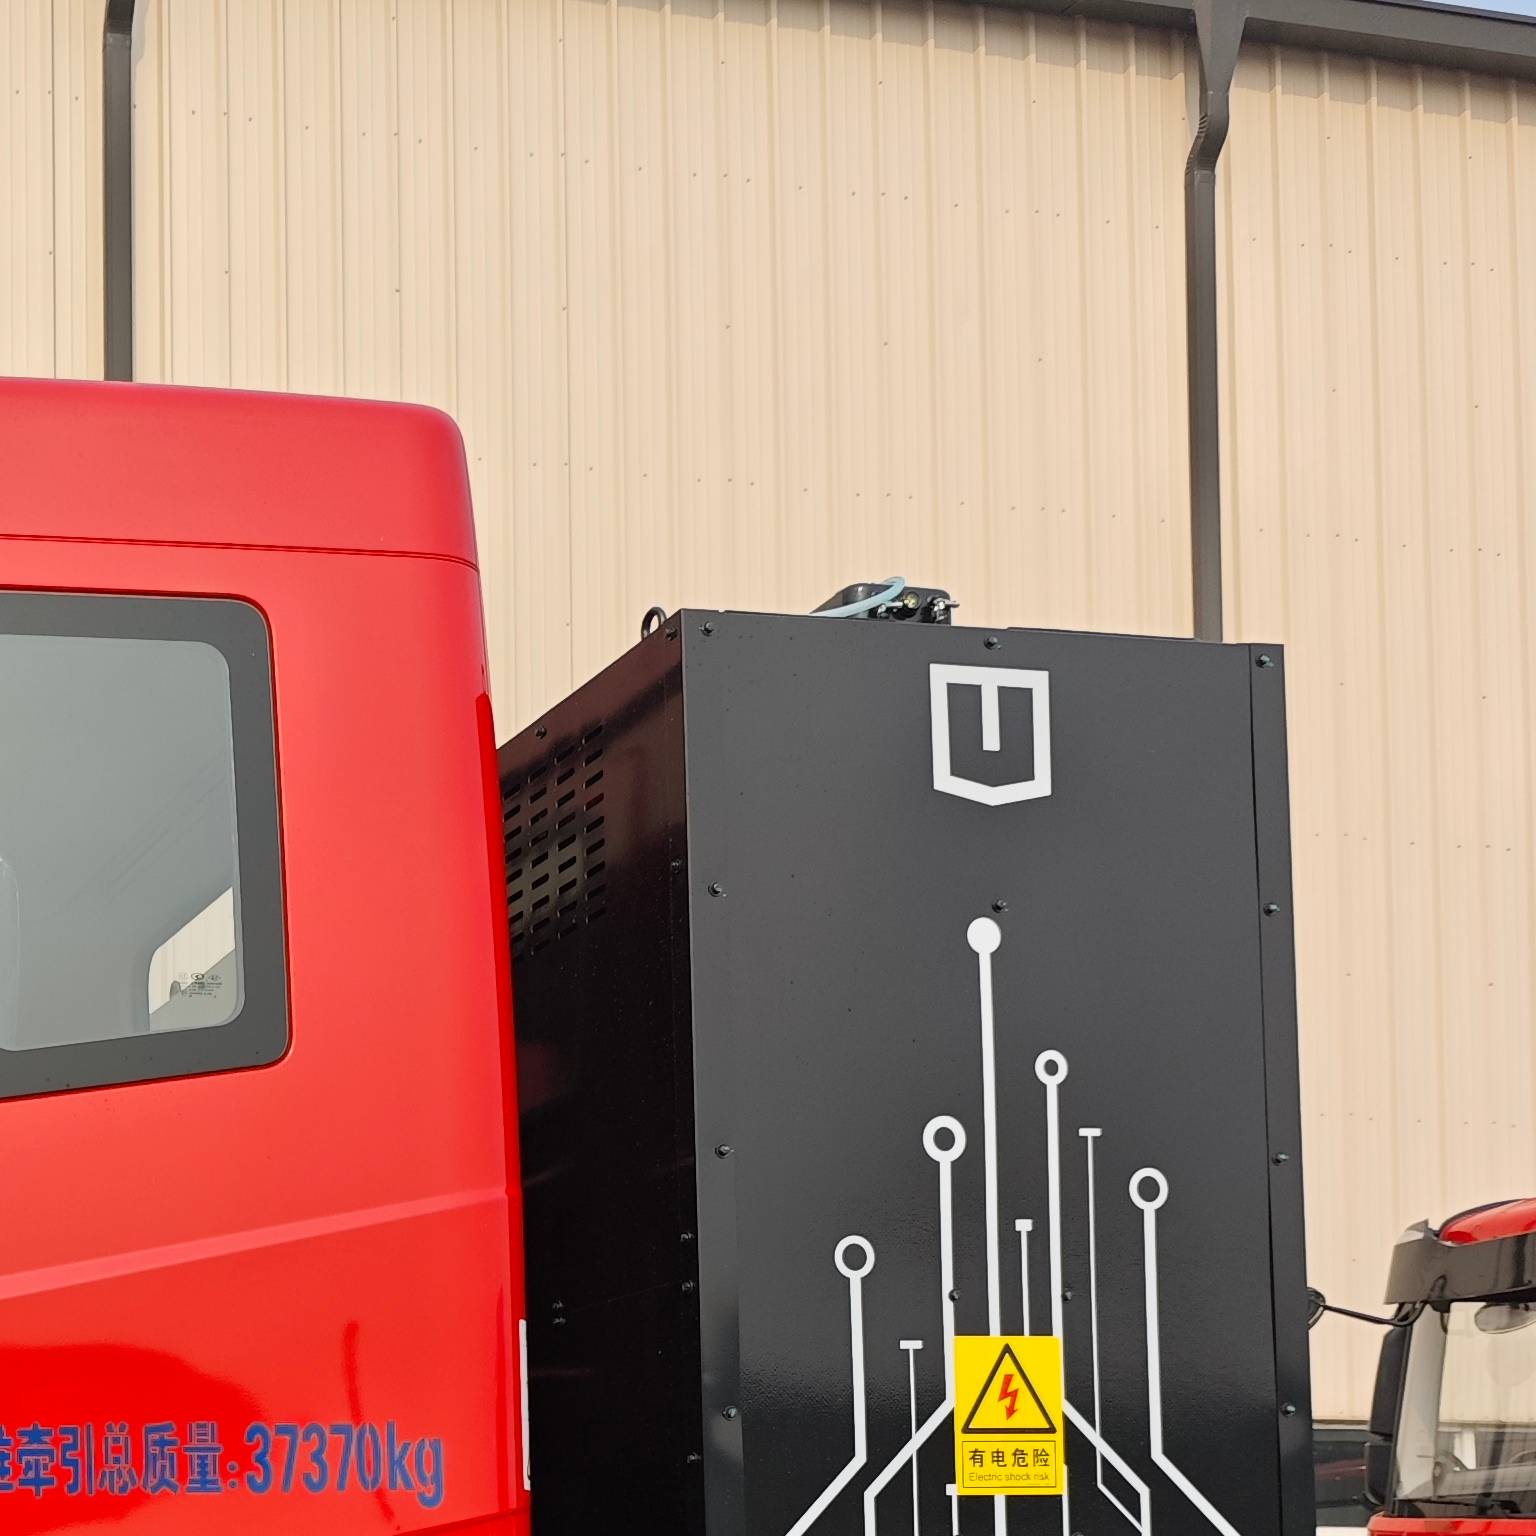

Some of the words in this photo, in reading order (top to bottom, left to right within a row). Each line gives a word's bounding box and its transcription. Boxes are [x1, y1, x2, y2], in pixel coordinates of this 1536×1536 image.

[968, 1448, 1050, 1468] 有电危险
[969, 1472, 1002, 1482] Electric
[1004, 1472, 1031, 1481] shock
[1034, 1472, 1049, 1481] risk
